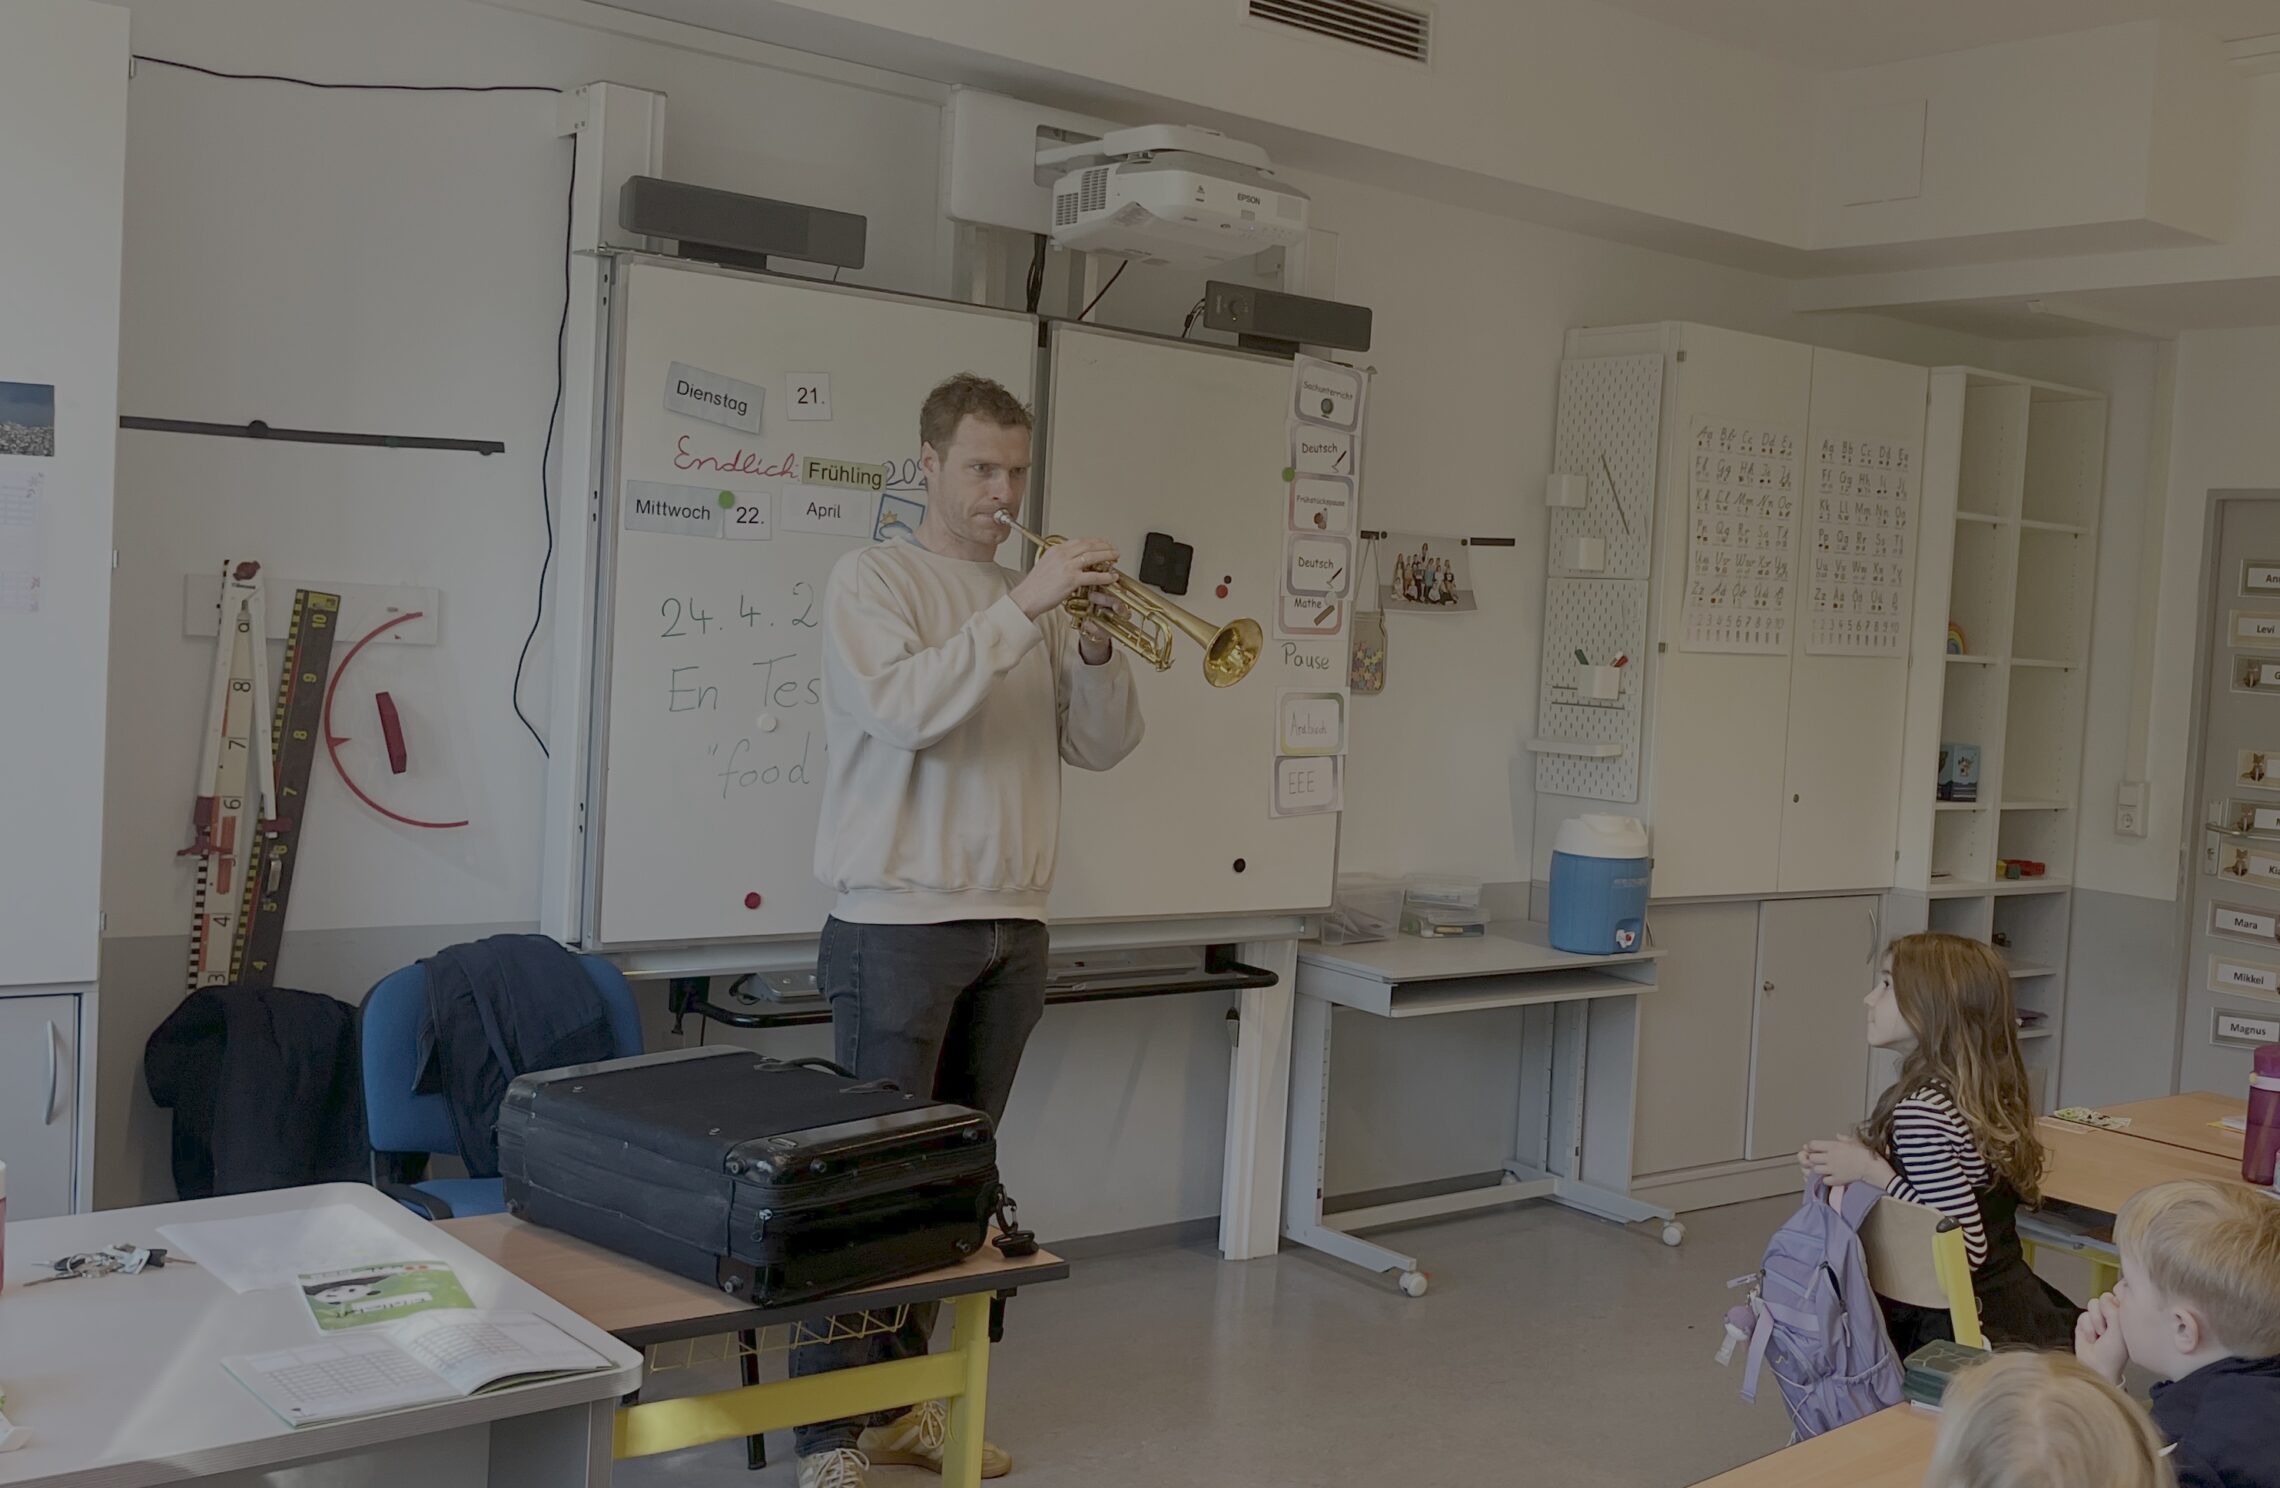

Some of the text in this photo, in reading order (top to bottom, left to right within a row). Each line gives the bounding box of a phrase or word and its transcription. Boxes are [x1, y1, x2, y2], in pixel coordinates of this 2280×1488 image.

[1237, 192, 1260, 205] EPSON
[1303, 380, 1353, 400] Sachunterricht
[676, 380, 825, 416] Dienstag 21.
[1302, 443, 1338, 454] Deutsch
[674, 435, 797, 479] Endlich
[808, 462, 882, 490] Frühling
[636, 498, 765, 524] Mittwoch 22.
[806, 501, 841, 519] April
[1298, 557, 1334, 569] Deutsch
[2266, 574, 2280, 584] An
[1294, 598, 1322, 609] Mathe
[311, 613, 328, 629] 10
[2256, 624, 2276, 634] Levi
[1281, 642, 1330, 670] Pause
[302, 672, 318, 684] 9
[232, 681, 251, 693] 8
[668, 666, 718, 712] En
[292, 730, 308, 741] 8
[228, 739, 247, 750] 7
[282, 786, 299, 797] 7
[223, 798, 242, 810] 6
[212, 916, 232, 928] 4
[2234, 917, 2258, 930] Mara
[207, 973, 226, 984] 3
[2233, 971, 2264, 985] Mikkel
[2230, 1023, 2267, 1036] Magnus
